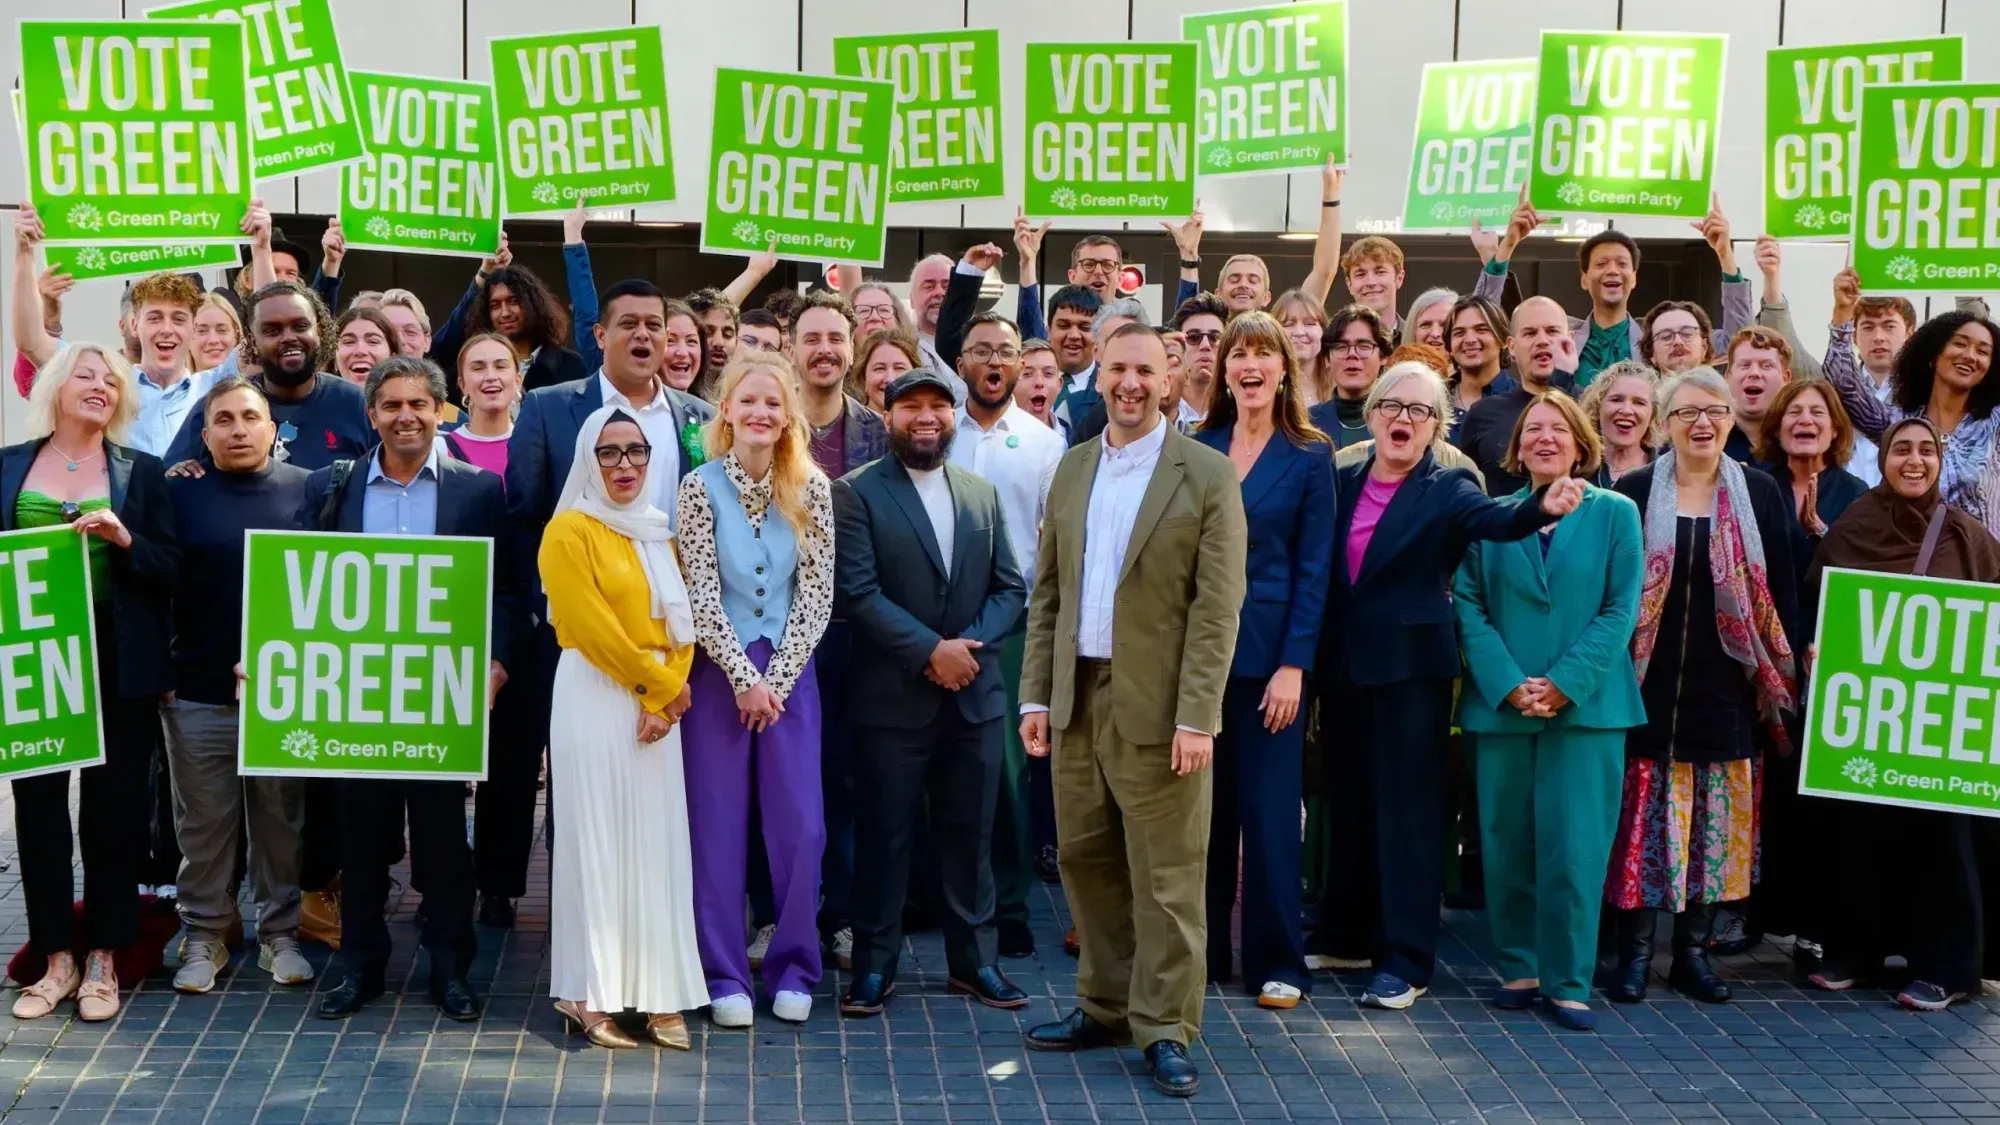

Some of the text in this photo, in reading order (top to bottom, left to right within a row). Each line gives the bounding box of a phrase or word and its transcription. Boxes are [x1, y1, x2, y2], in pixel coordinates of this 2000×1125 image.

[198, 0, 313, 66] TE
[1206, 14, 1321, 80] VOTE
[53, 36, 213, 111] VOTE
[249, 63, 346, 140] EEN
[516, 40, 642, 108] VOTE
[857, 41, 976, 103] VOTE
[1050, 54, 1172, 114] VOTE
[1447, 72, 1533, 132] VOT
[1567, 45, 1696, 110] VOTE
[368, 84, 480, 152] VOTE
[741, 81, 868, 153] VOTE
[891, 106, 994, 169] EEN
[1199, 76, 1337, 144] GREEN
[1892, 97, 2000, 170] VOT
[38, 121, 240, 195] GREEN
[294, 142, 335, 159] Party
[507, 107, 665, 178] GREEN
[1033, 121, 1187, 181] GREEN
[1236, 146, 1321, 164] Green Party
[1418, 136, 1531, 195] GREE
[1541, 114, 1707, 181] GREEN
[349, 151, 494, 220] GREEN
[562, 181, 650, 199] Green Party
[716, 151, 879, 225] GREEN
[896, 177, 979, 194] Green Party
[1081, 194, 1169, 210] Green Party
[1457, 205, 1499, 218] Green
[1589, 190, 1683, 210] Green Party
[1865, 178, 2000, 249] GREE
[107, 210, 220, 229] Green Party
[395, 225, 476, 246] Green Party
[764, 230, 856, 252] Green Party
[110, 244, 206, 265] Green Party
[1923, 264, 1980, 279] Green
[284, 550, 454, 633] VOTE
[1859, 588, 2000, 678] VOTE
[256, 640, 474, 726] GREEN
[11, 736, 65, 757] Party
[325, 739, 448, 763] Green Party
[1883, 769, 2000, 801] Green Party
